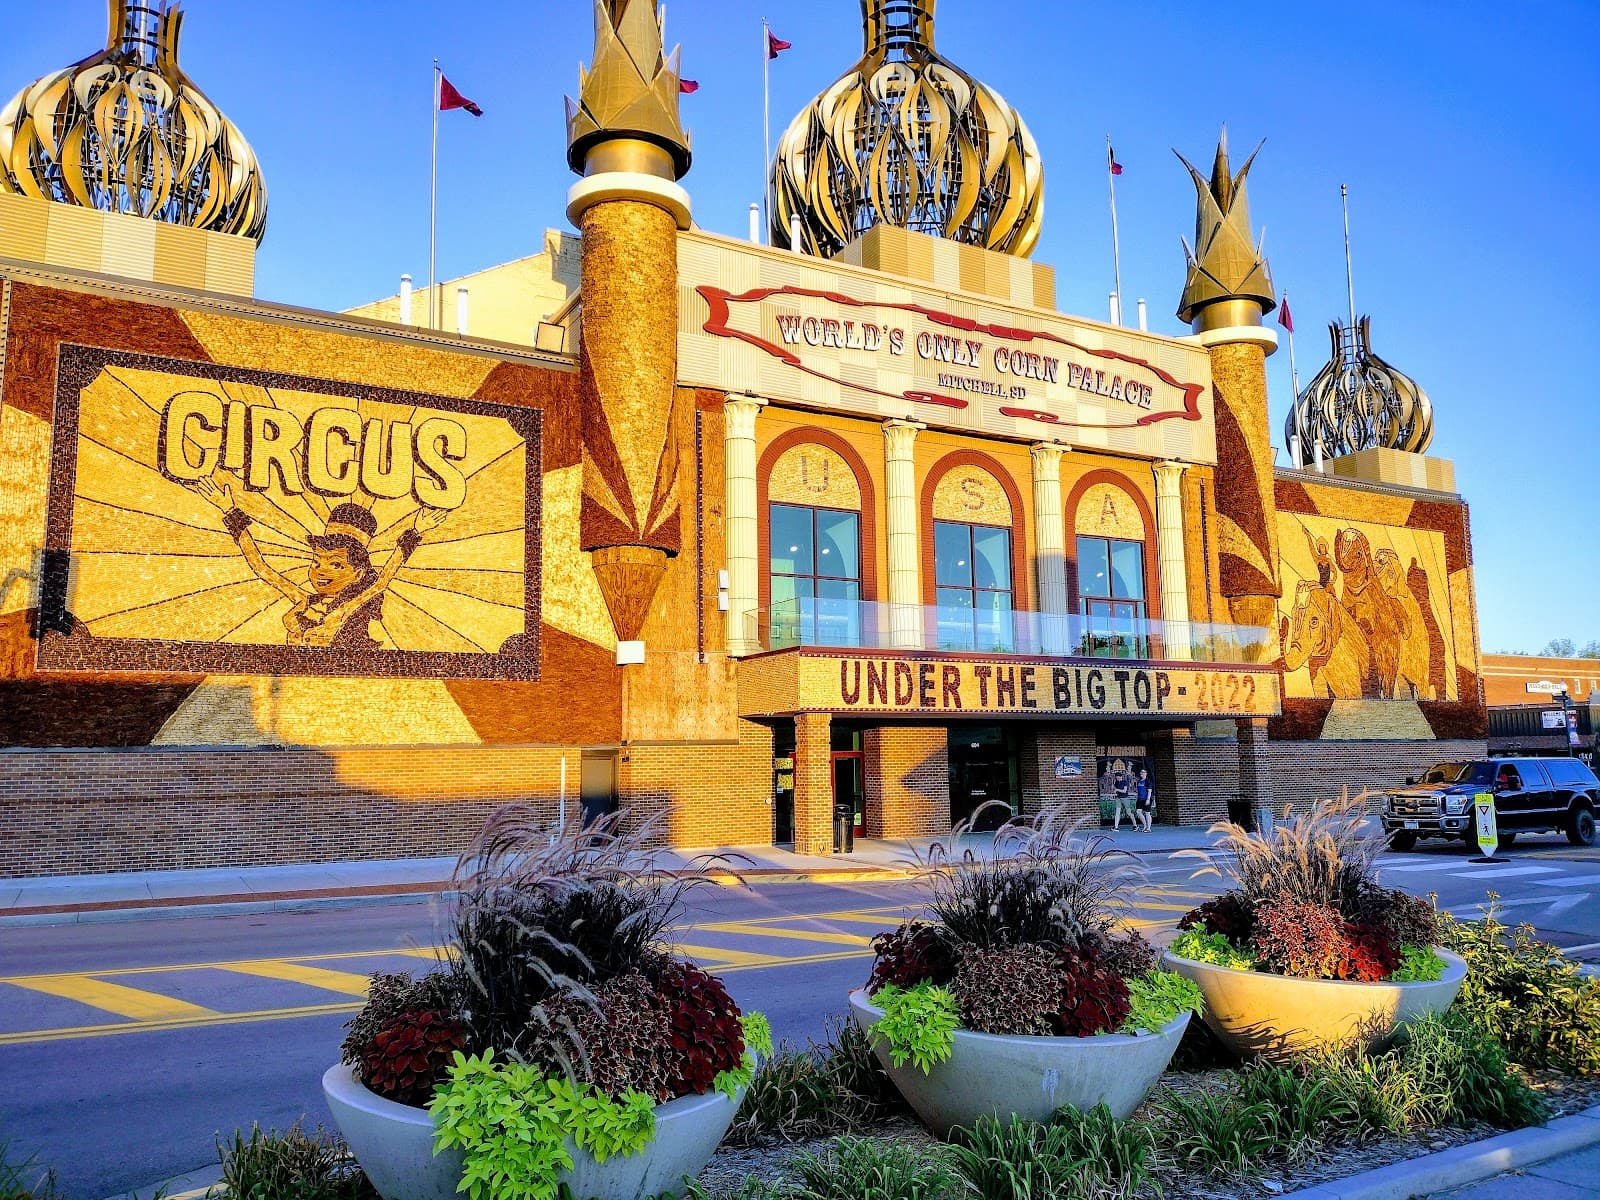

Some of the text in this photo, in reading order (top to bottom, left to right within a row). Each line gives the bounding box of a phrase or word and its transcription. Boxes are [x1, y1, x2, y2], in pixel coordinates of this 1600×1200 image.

[776, 314, 1153, 409] WORLD'S ONLY CORN PALACE
[938, 373, 1027, 399] MITCHELL, SD
[157, 391, 468, 510] CIRCUS
[840, 661, 961, 707] UNDER
[974, 666, 1037, 707] THE
[1053, 668, 1104, 710] BIG
[1194, 672, 1257, 712] 2022
